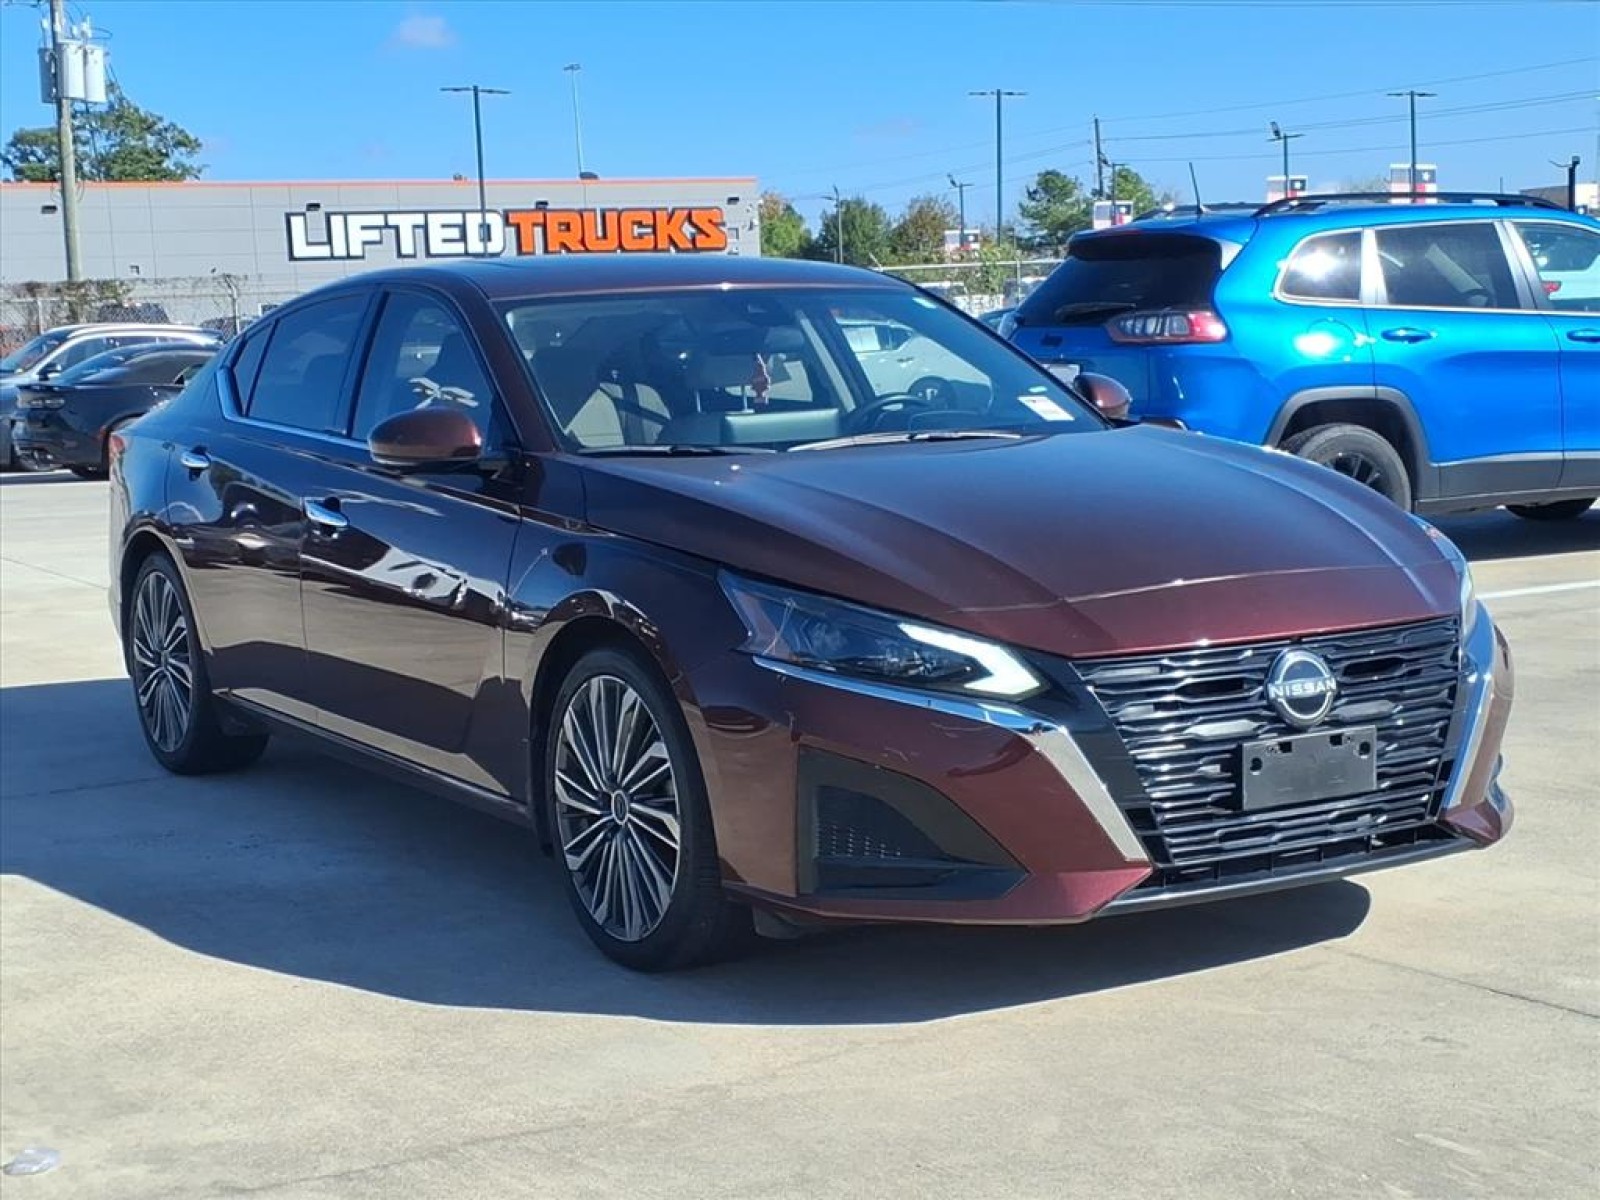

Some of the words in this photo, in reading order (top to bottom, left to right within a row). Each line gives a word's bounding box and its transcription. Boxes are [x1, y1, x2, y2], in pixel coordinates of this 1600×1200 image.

[286, 209, 505, 261] LIFTED
[502, 206, 727, 256] TRUCKS
[1269, 677, 1337, 699] NISSAN
